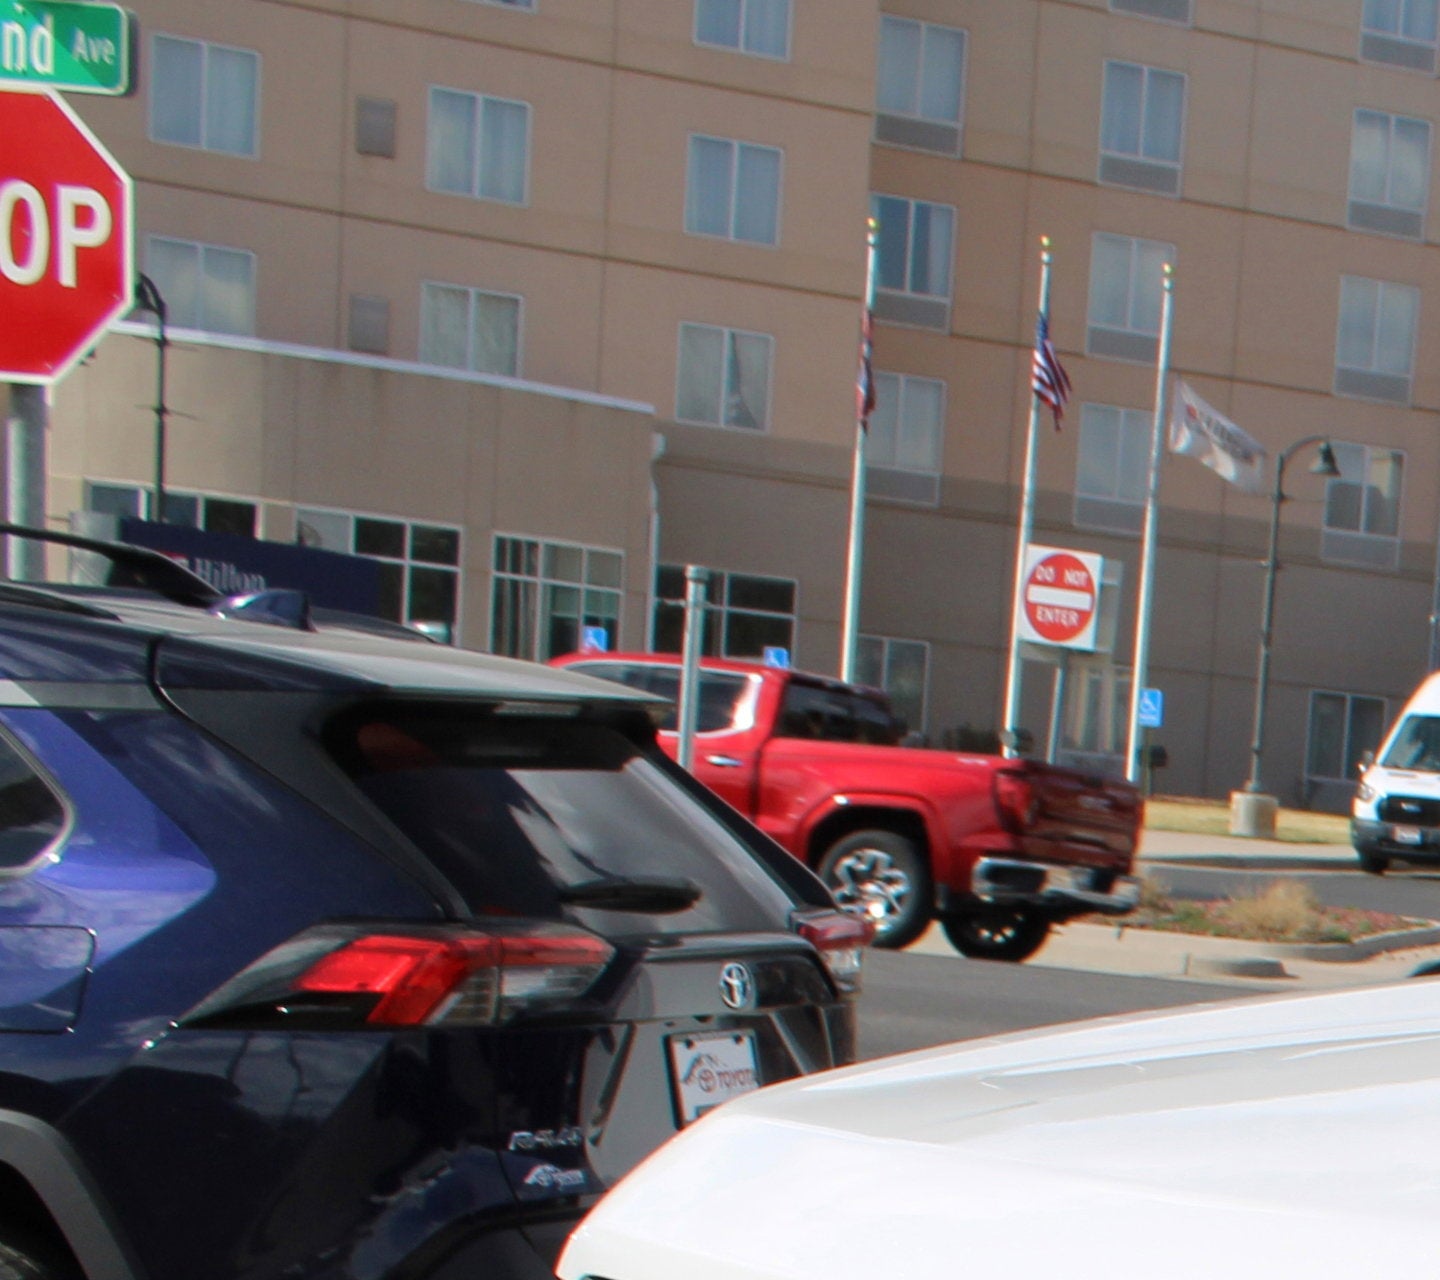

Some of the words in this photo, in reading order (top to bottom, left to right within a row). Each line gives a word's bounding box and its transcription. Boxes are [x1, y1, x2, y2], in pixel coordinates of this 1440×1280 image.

[72, 26, 115, 65] Ave
[194, 557, 267, 594] Hilton
[1035, 564, 1056, 583] DO
[1064, 568, 1089, 587] NOT
[1036, 605, 1079, 629] ENTER
